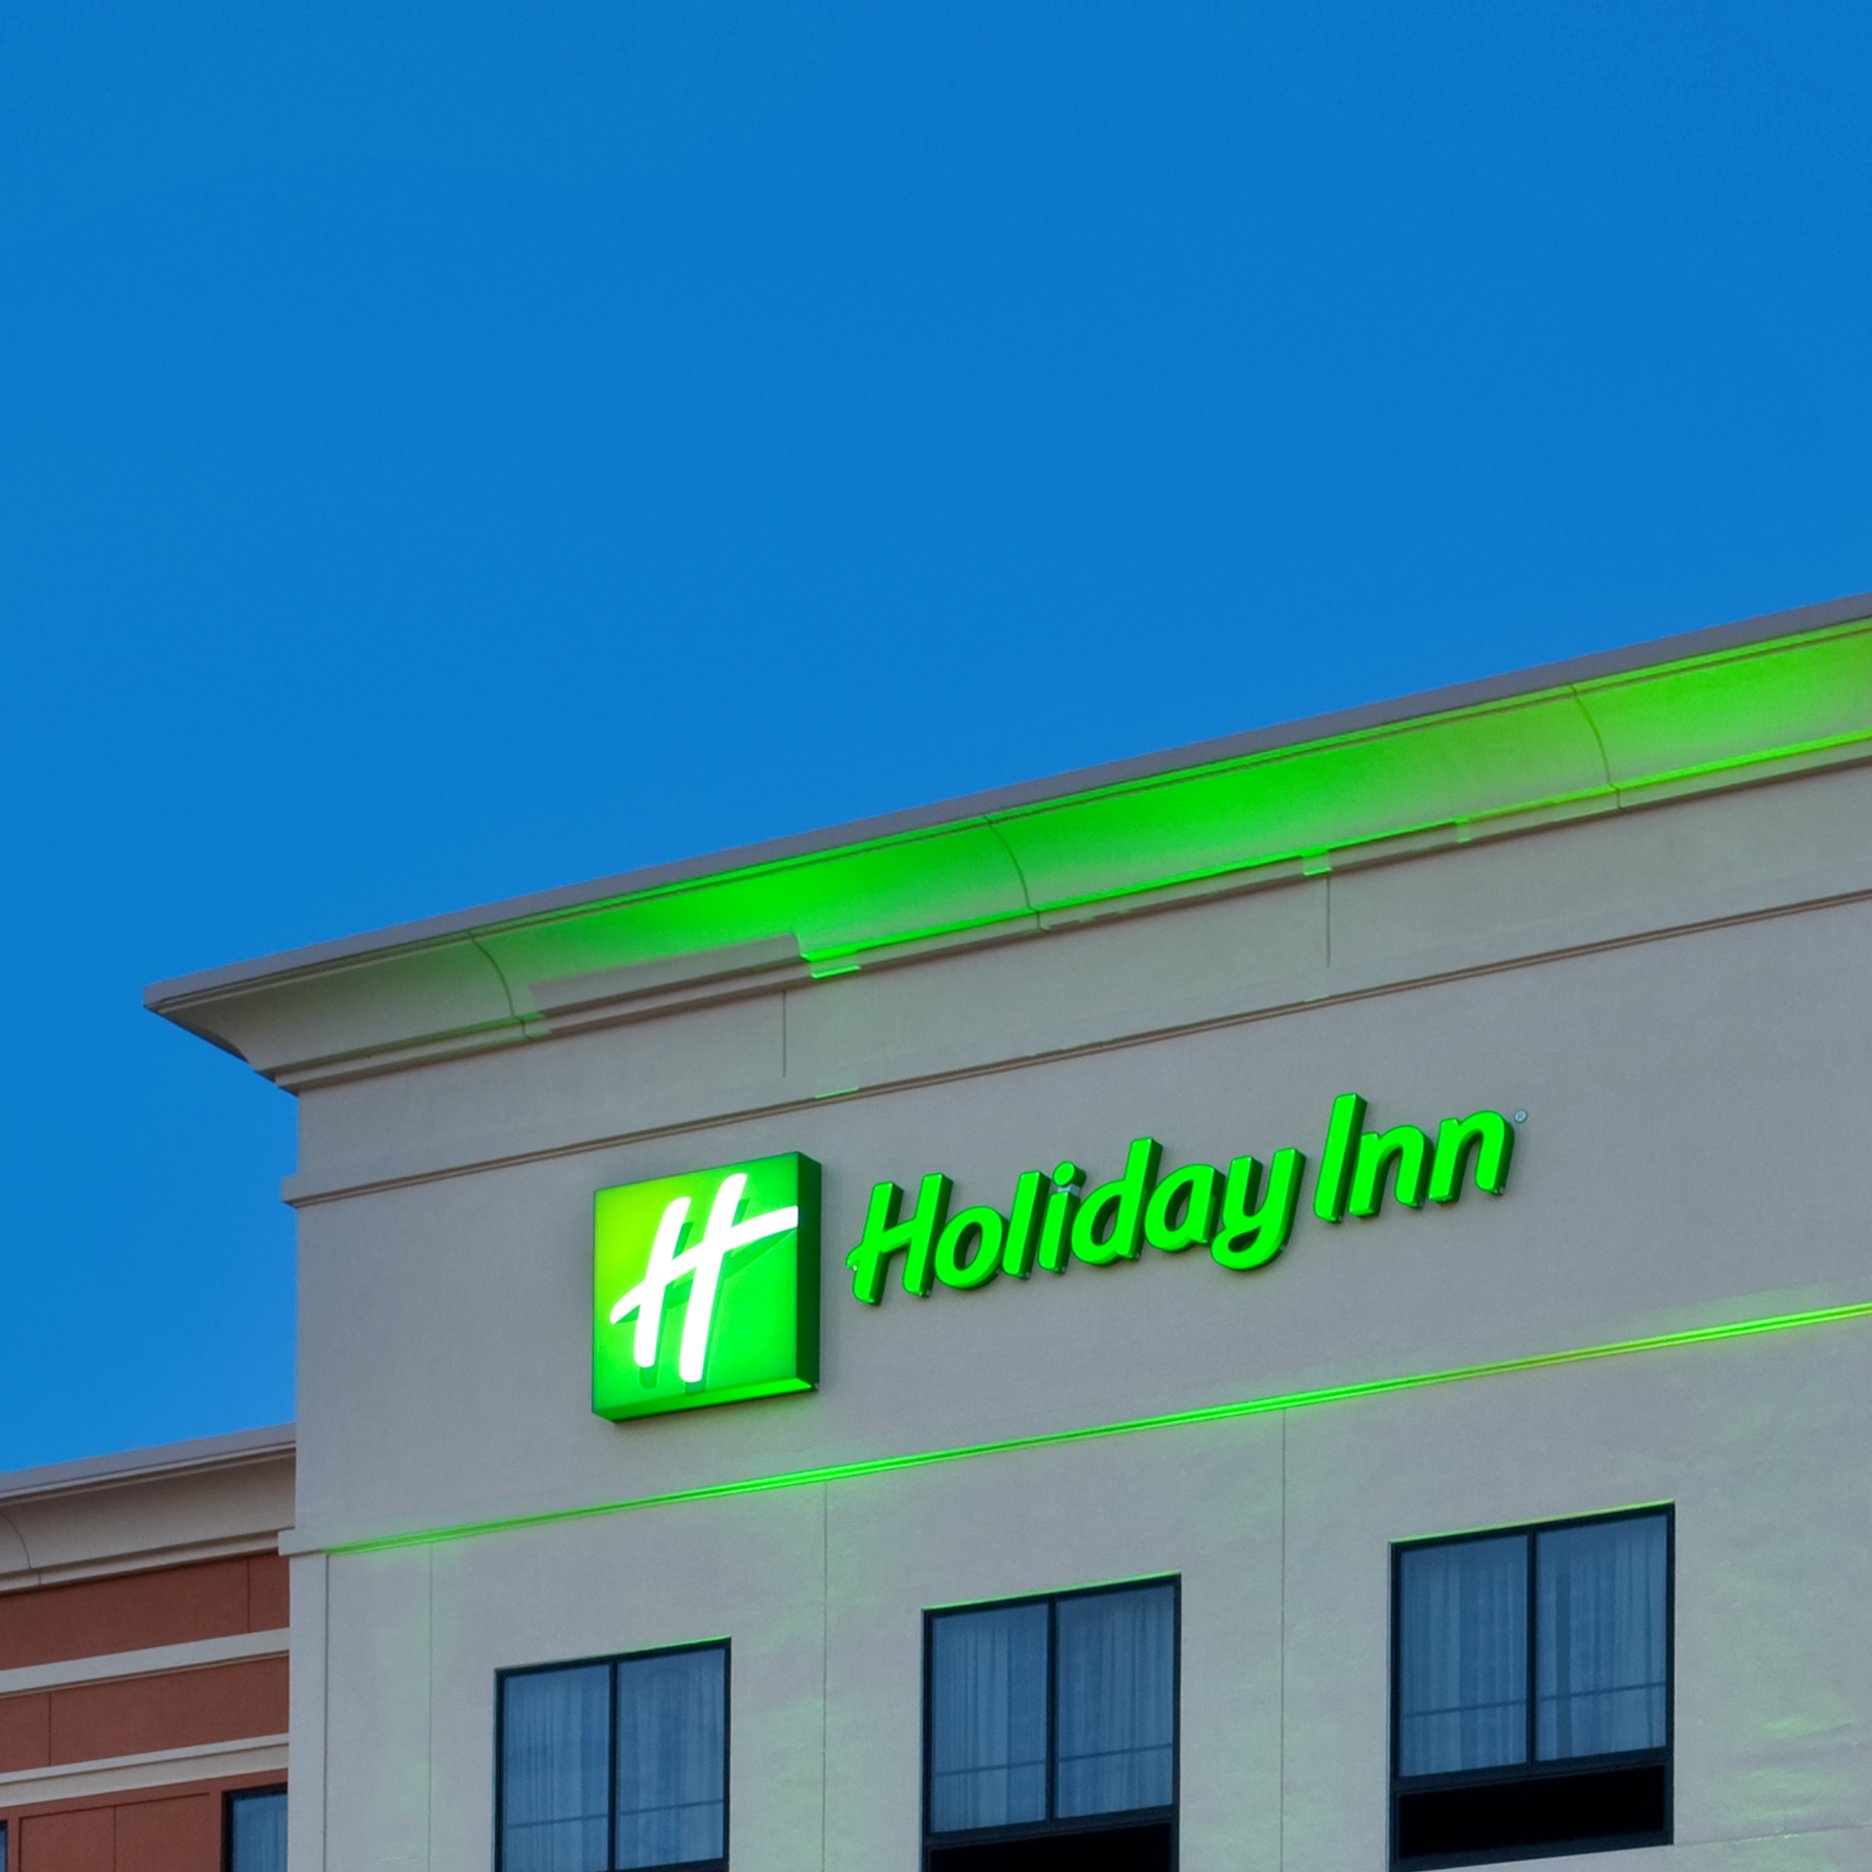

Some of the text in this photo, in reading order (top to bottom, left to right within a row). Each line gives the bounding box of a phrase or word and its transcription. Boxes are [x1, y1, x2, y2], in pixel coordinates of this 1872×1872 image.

[609, 1172, 800, 1384] H
[846, 1092, 1514, 1306] Holiday Inn
